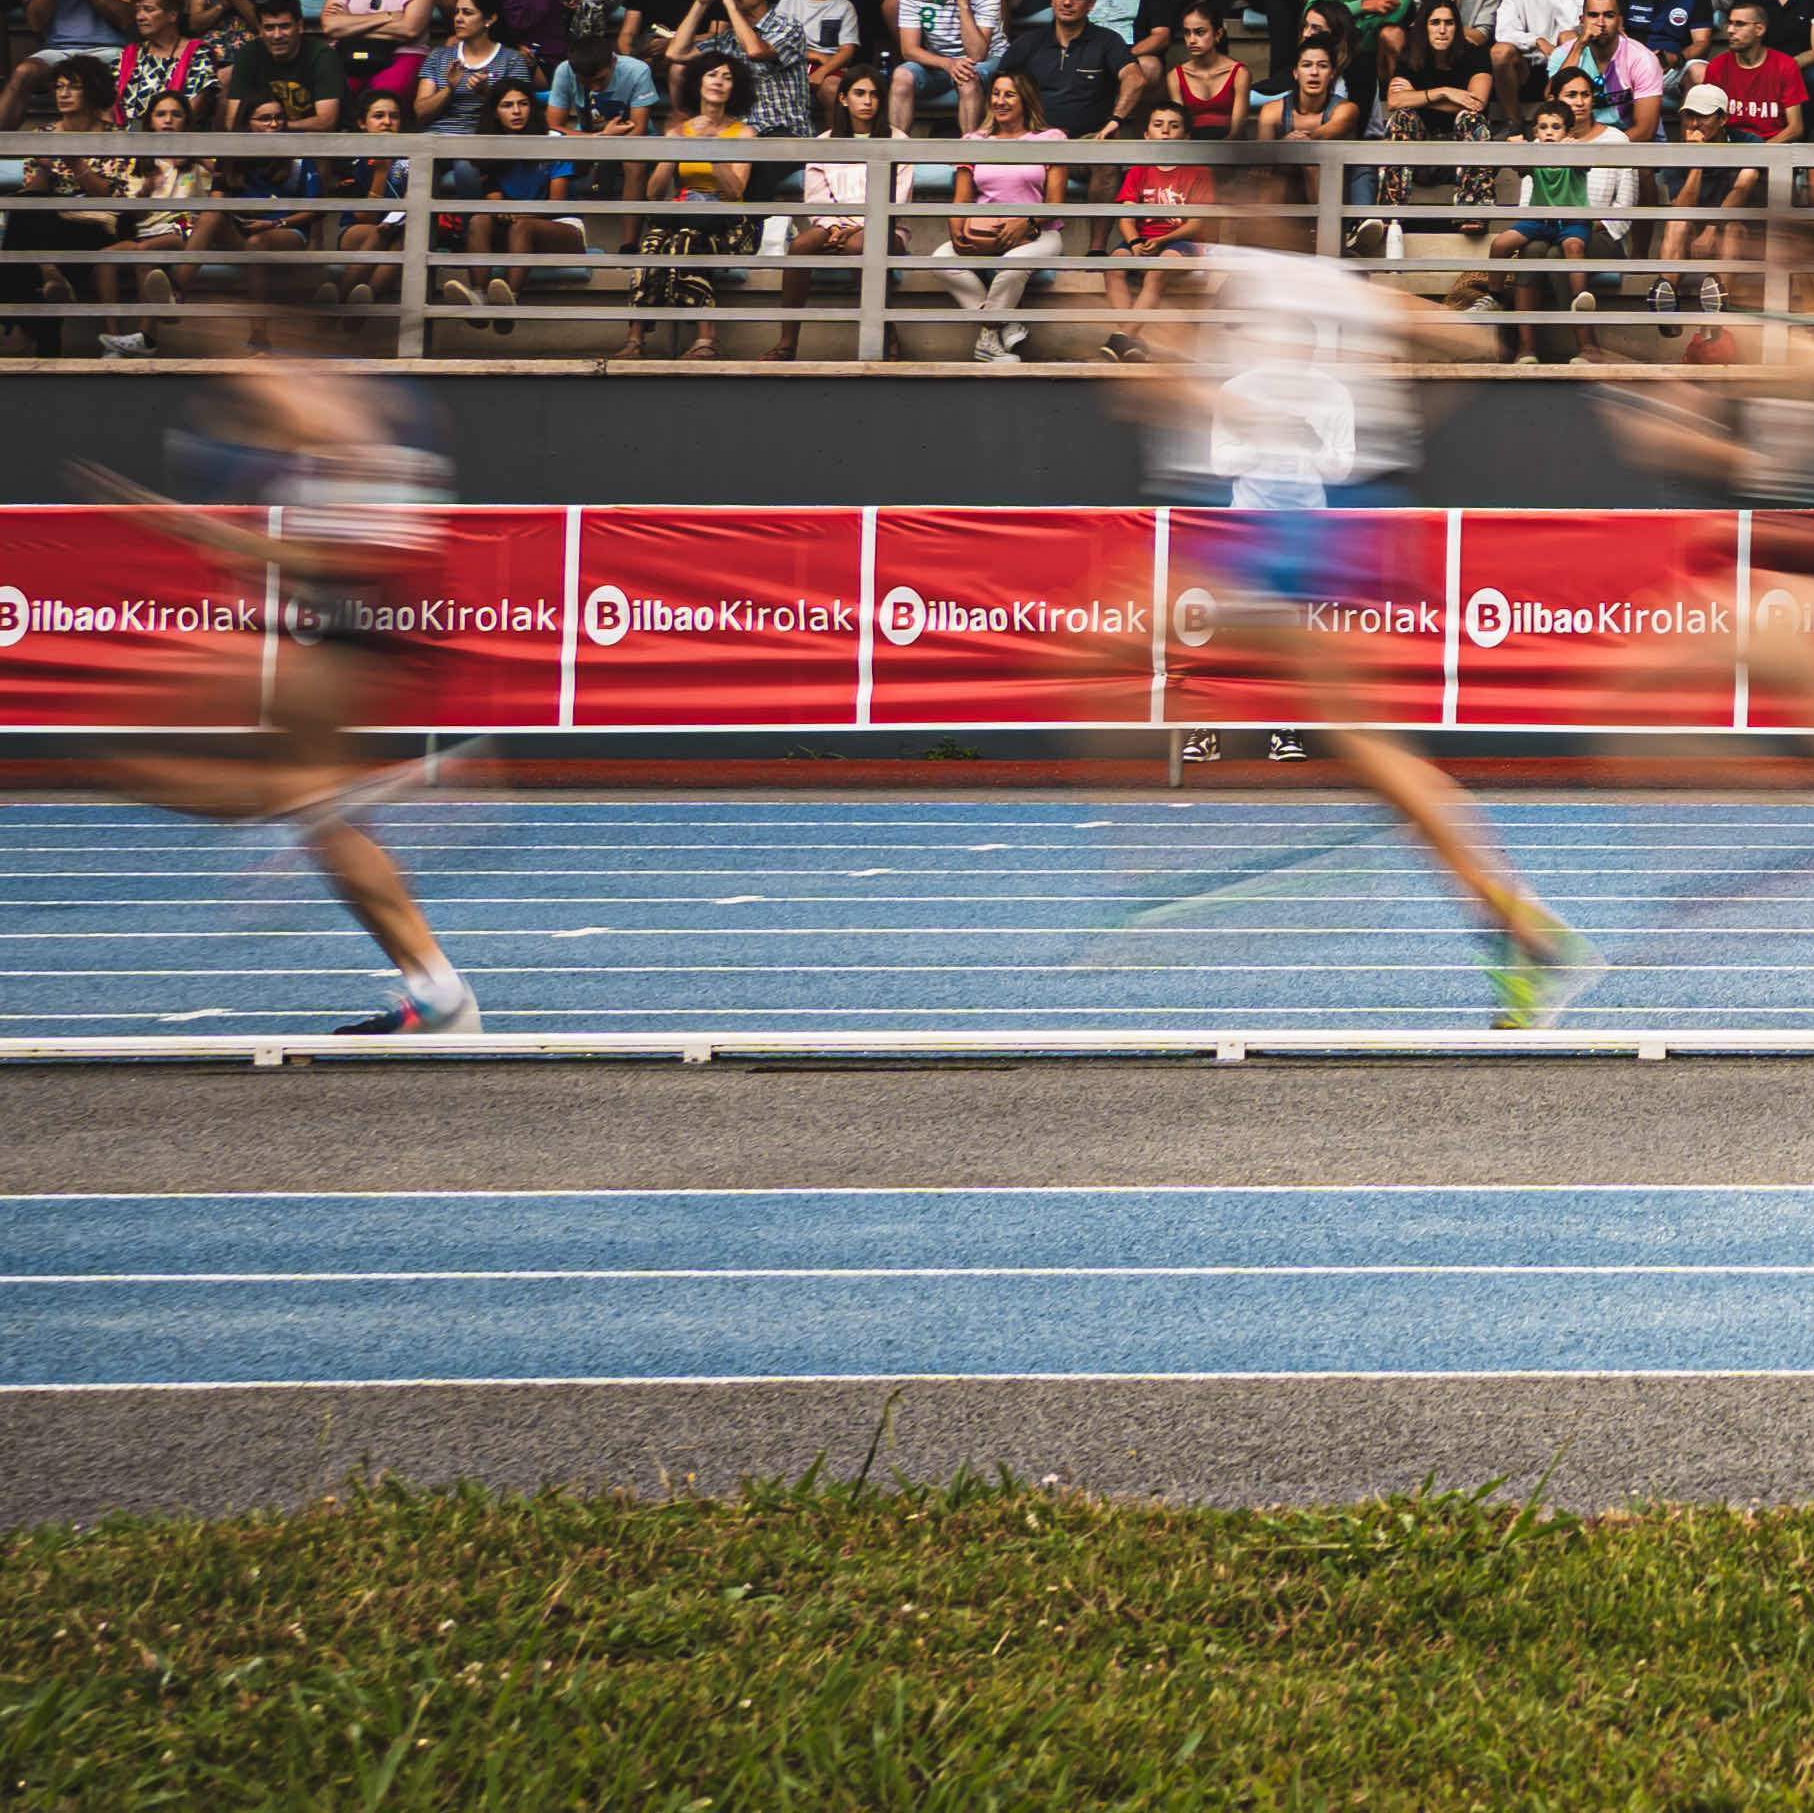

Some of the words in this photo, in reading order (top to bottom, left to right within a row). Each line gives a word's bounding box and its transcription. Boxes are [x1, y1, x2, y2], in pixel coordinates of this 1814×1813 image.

[0, 598, 259, 634] BilbaoKirolak
[592, 597, 854, 634] BilbaoKirolak
[887, 597, 1147, 635] BilbaoKirolak
[1474, 599, 1730, 637] BilbaoKirolak
